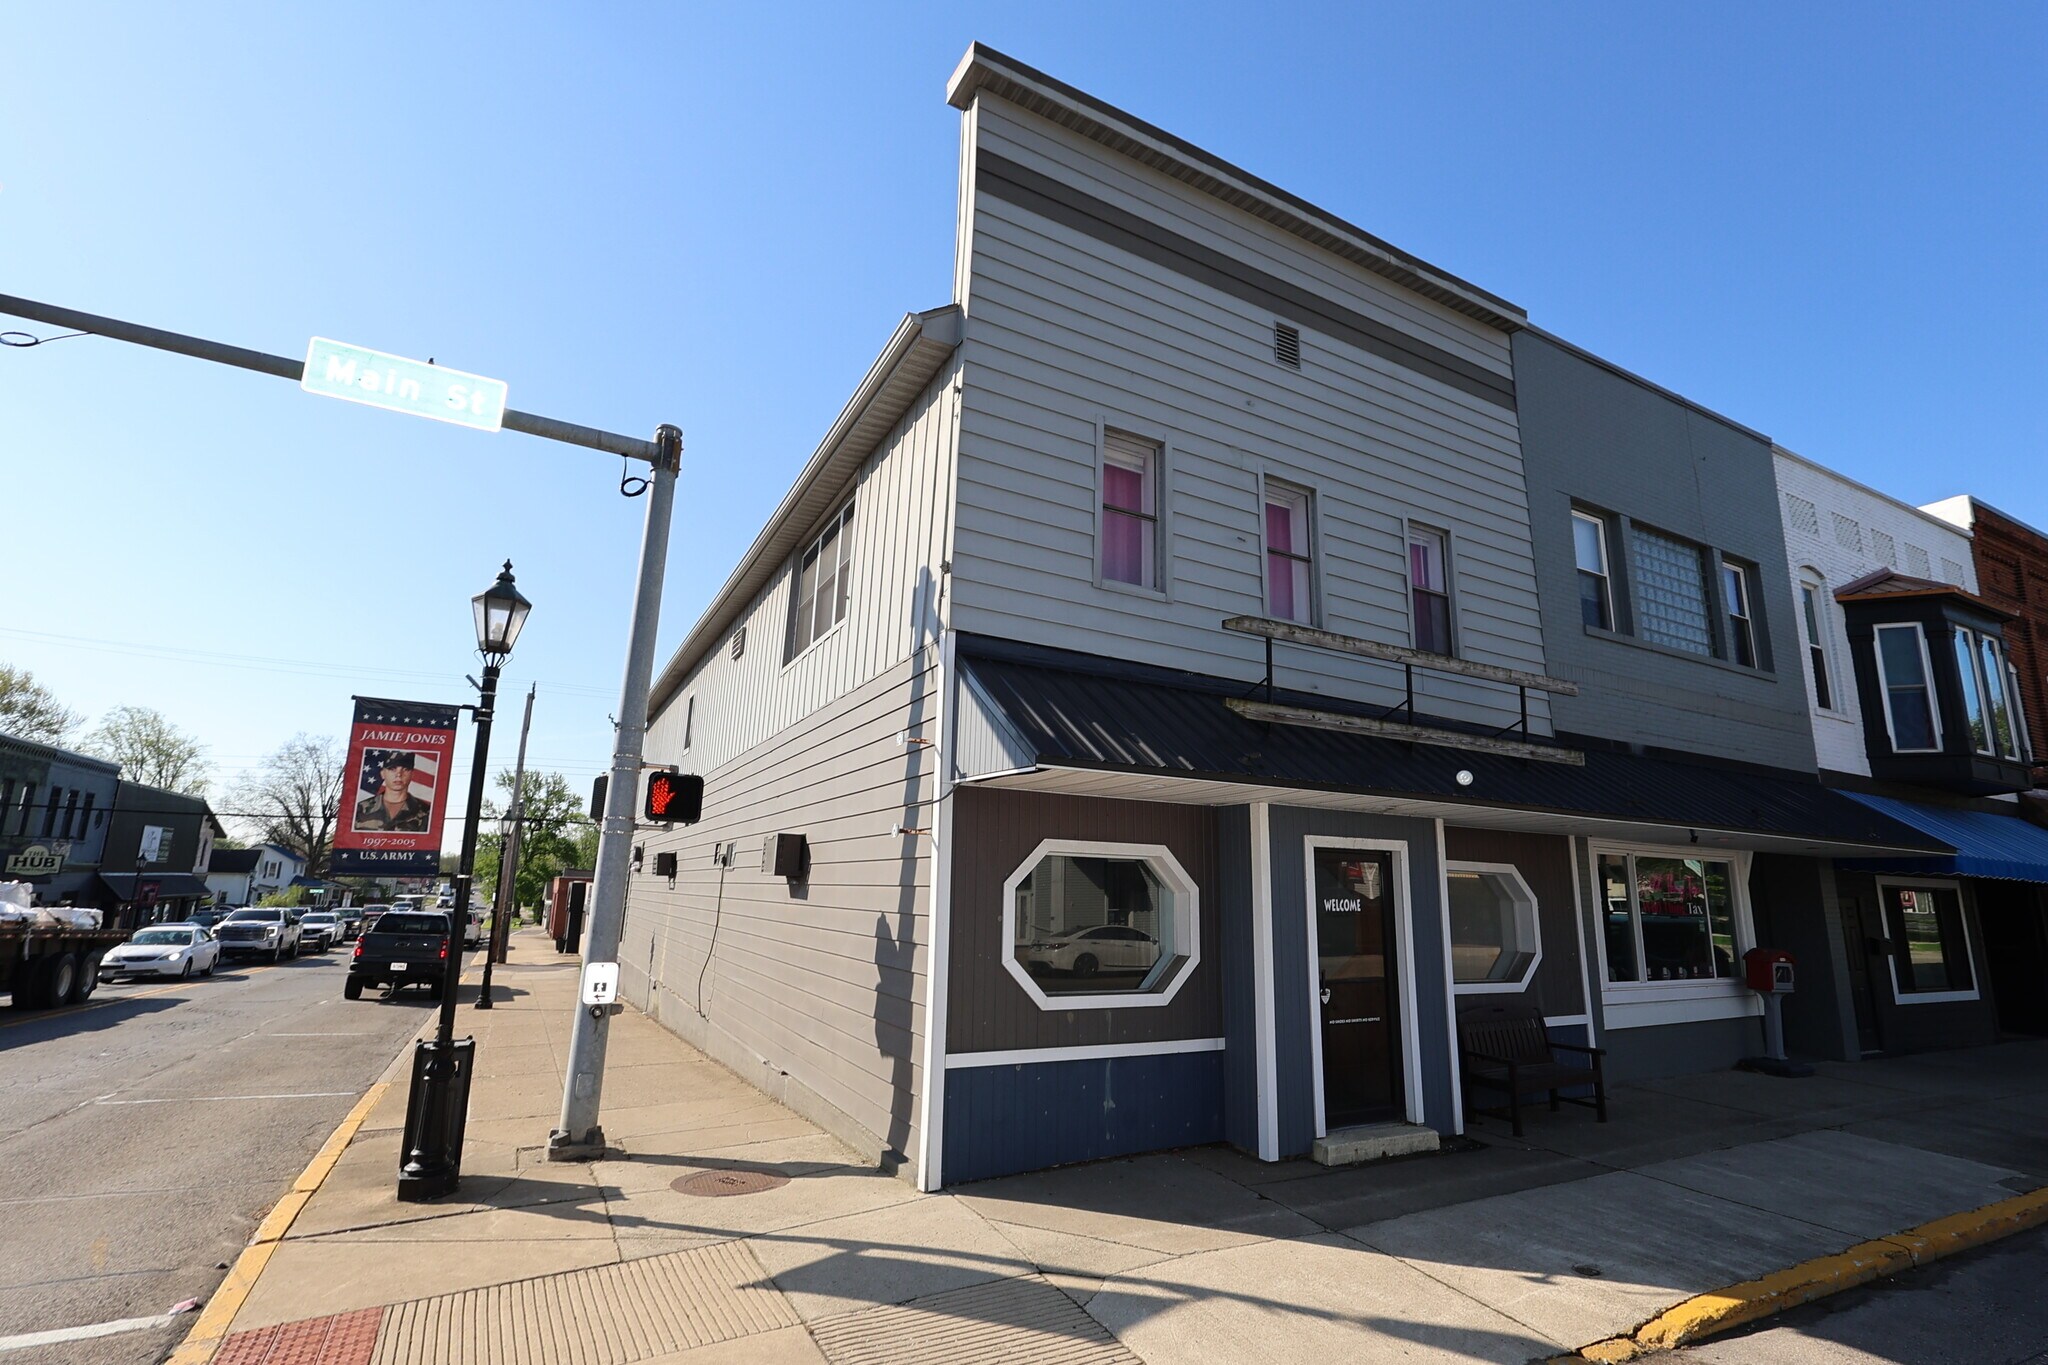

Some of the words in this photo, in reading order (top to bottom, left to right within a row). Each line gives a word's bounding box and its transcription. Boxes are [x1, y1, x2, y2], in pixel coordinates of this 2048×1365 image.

[325, 354, 421, 400] Main
[445, 384, 486, 415] St
[360, 730, 403, 742] JAMIE
[403, 732, 447, 745] JONES
[362, 837, 416, 848] 1997-2005
[12, 857, 56, 867] HUB
[360, 851, 379, 861] U.S.
[380, 851, 416, 861] ARMY
[1323, 898, 1361, 912] WELCOME
[1687, 902, 1703, 914] Tax
